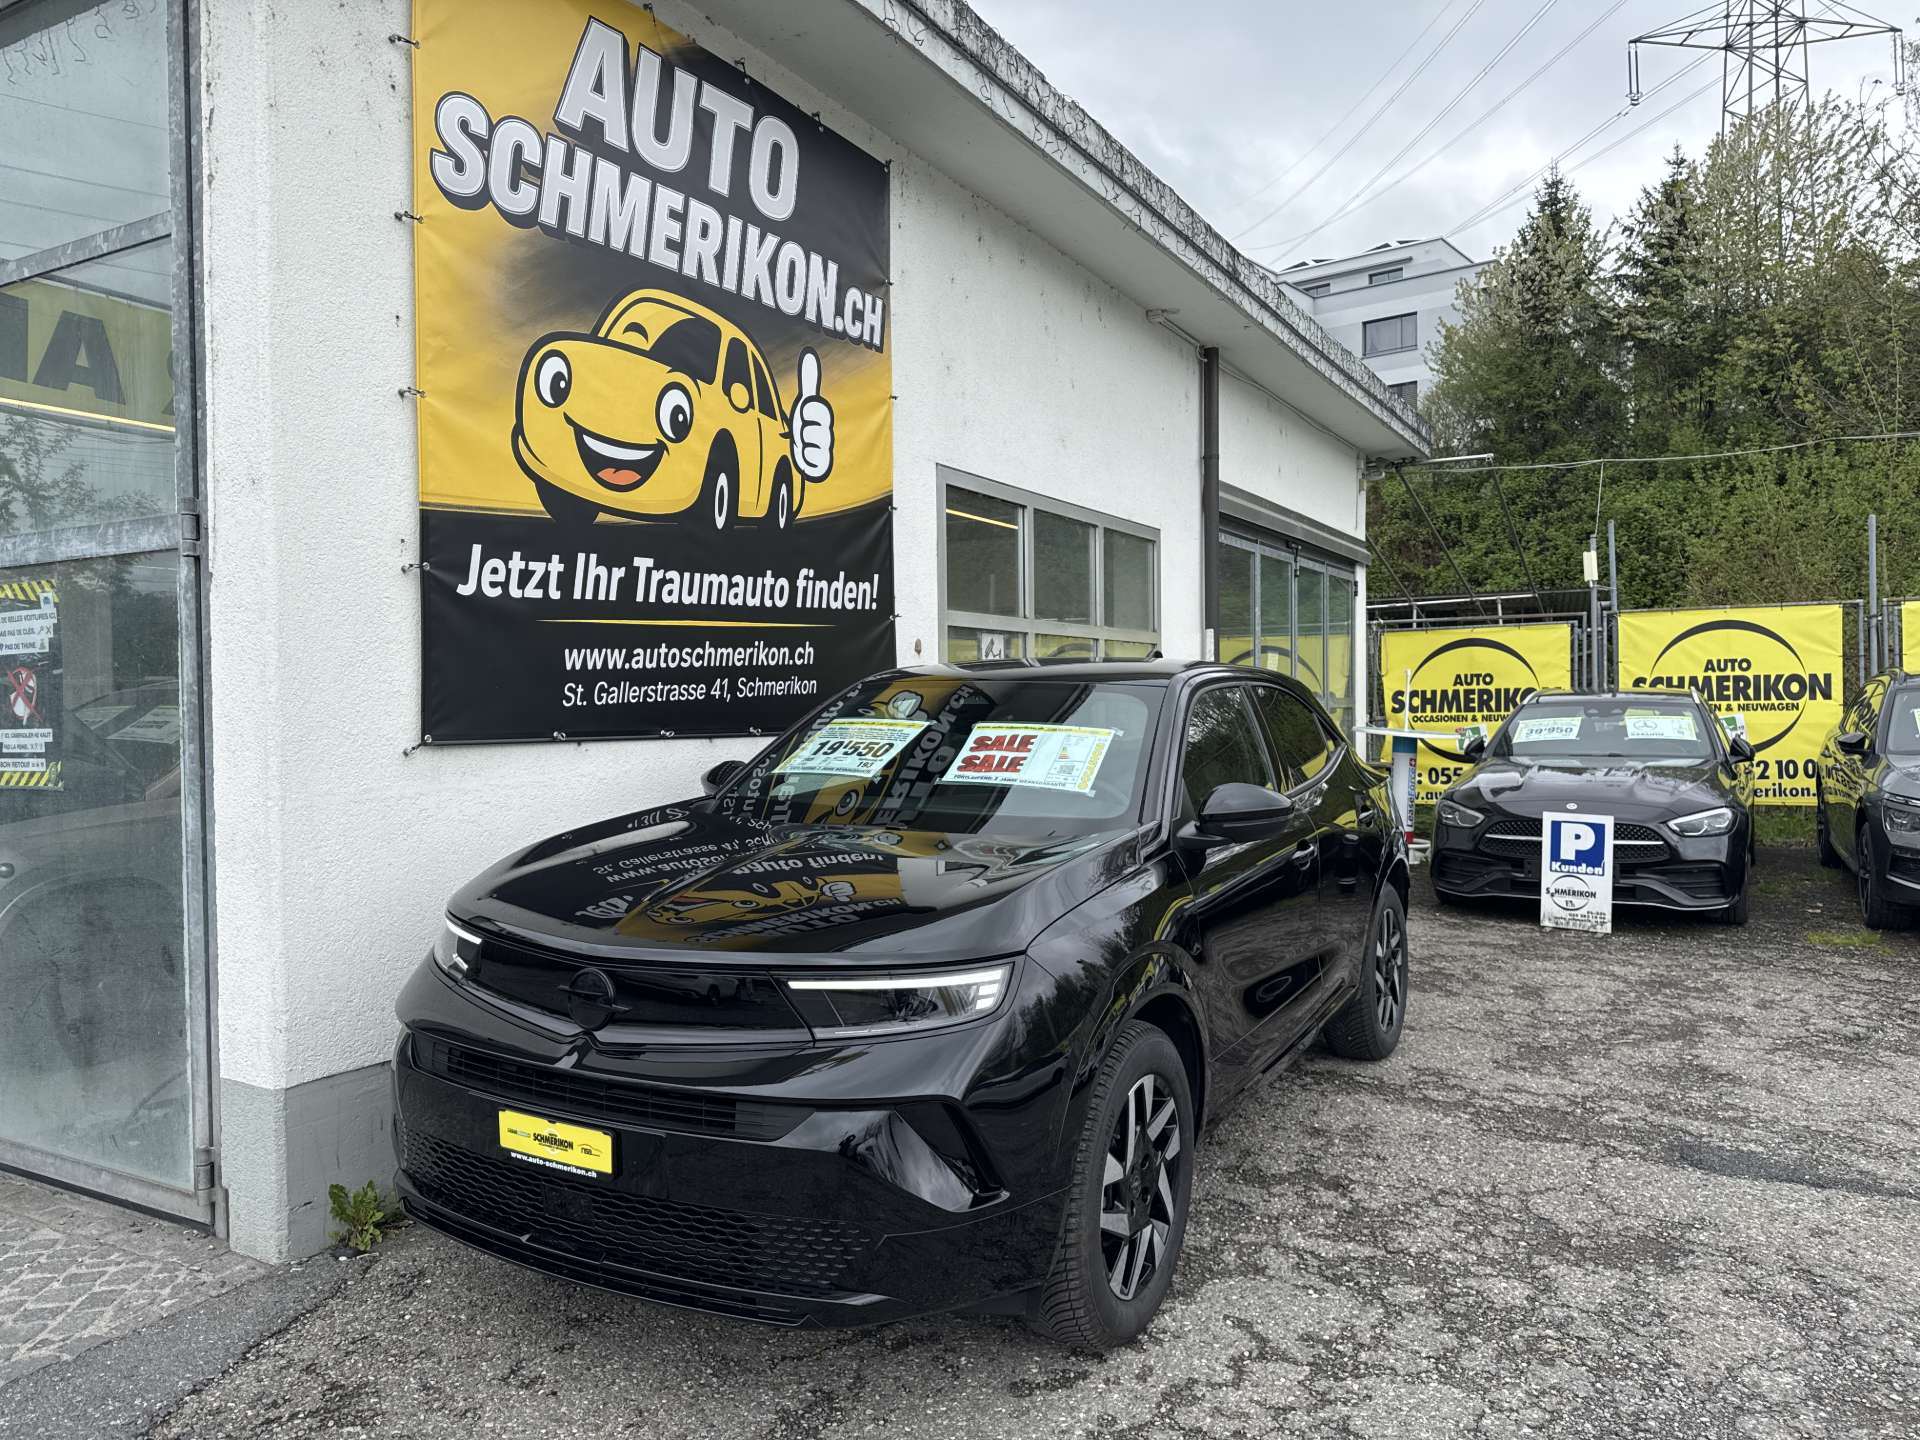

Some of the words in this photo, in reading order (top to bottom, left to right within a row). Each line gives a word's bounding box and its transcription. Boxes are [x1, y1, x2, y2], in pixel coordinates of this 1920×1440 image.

[554, 16, 800, 222] AUTO
[430, 92, 886, 352] SCHMERIKON.CH
[456, 543, 564, 600] Jetzt
[572, 551, 625, 602] Ihr
[633, 556, 790, 608] Traumauto
[796, 568, 880, 610] finden!
[564, 640, 815, 671] www.autoschmerikon.ch
[1704, 658, 1752, 673] AUTO
[1453, 673, 1494, 687] AUTO
[563, 682, 587, 707] St.
[594, 681, 706, 706] Gallerstrasse
[711, 680, 731, 703] 41,
[737, 676, 817, 699] Schmerikon
[1725, 703, 1733, 712] &
[1737, 702, 1800, 712] NEUWAGEN
[1412, 714, 1468, 723] OCCASIONEN
[1471, 714, 1478, 722] &
[811, 739, 894, 758] 19'550
[969, 734, 1039, 753] SALE
[956, 754, 1028, 773] SALE
[1775, 760, 1799, 779] 10
[1560, 822, 1596, 860] P
[1551, 861, 1603, 875] Kunden
[532, 1132, 574, 1151] SCHMERIKON
[510, 1151, 597, 1179] www.auto-schmerikon.ch
